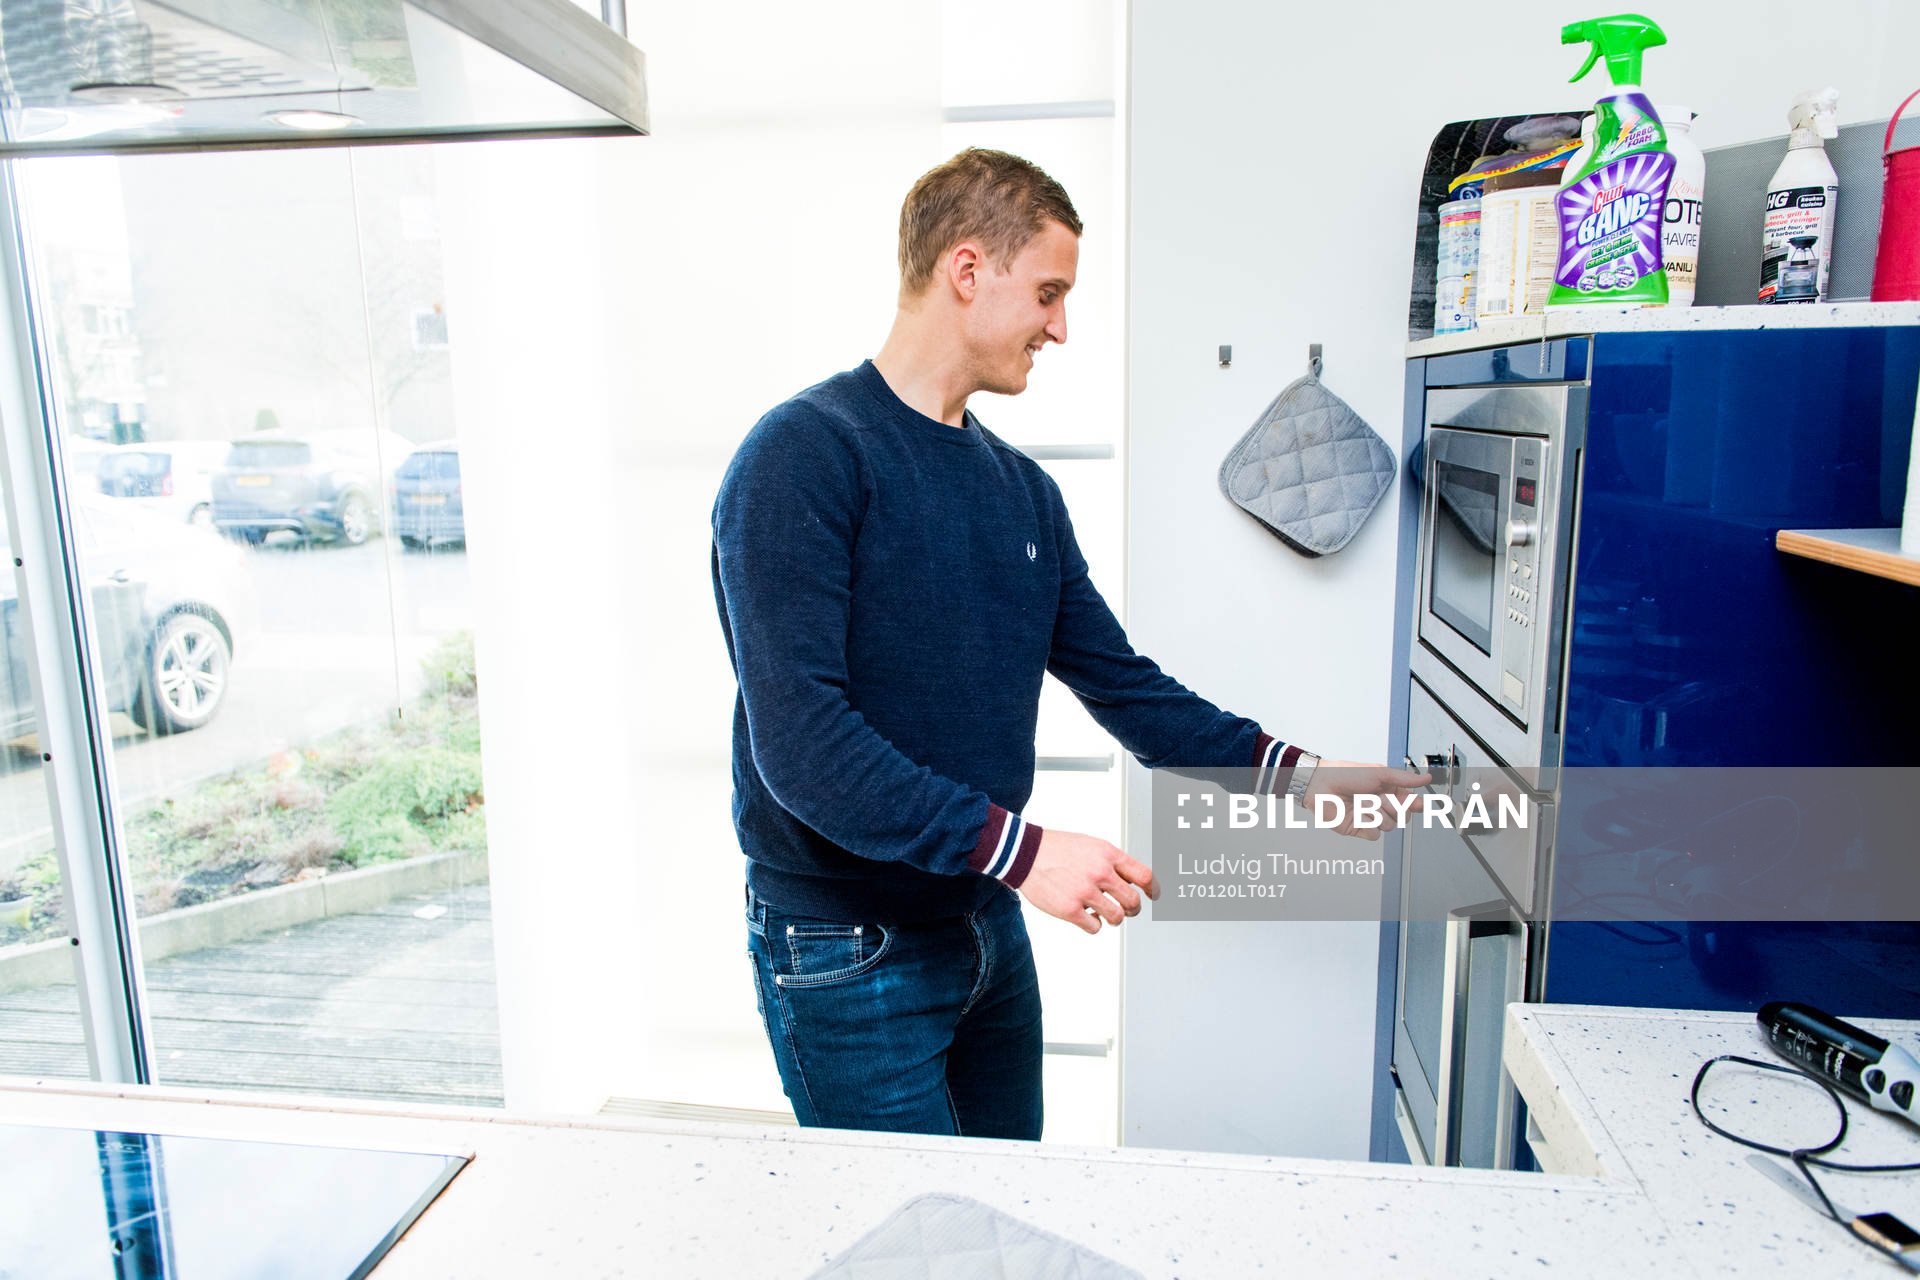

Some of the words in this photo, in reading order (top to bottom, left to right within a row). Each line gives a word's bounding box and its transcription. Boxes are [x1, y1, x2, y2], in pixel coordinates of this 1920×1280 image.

[1624, 126, 1654, 143] TURBO
[1627, 135, 1653, 148] FOAM
[1767, 191, 1790, 209] HG
[1577, 192, 1652, 246] BANG
